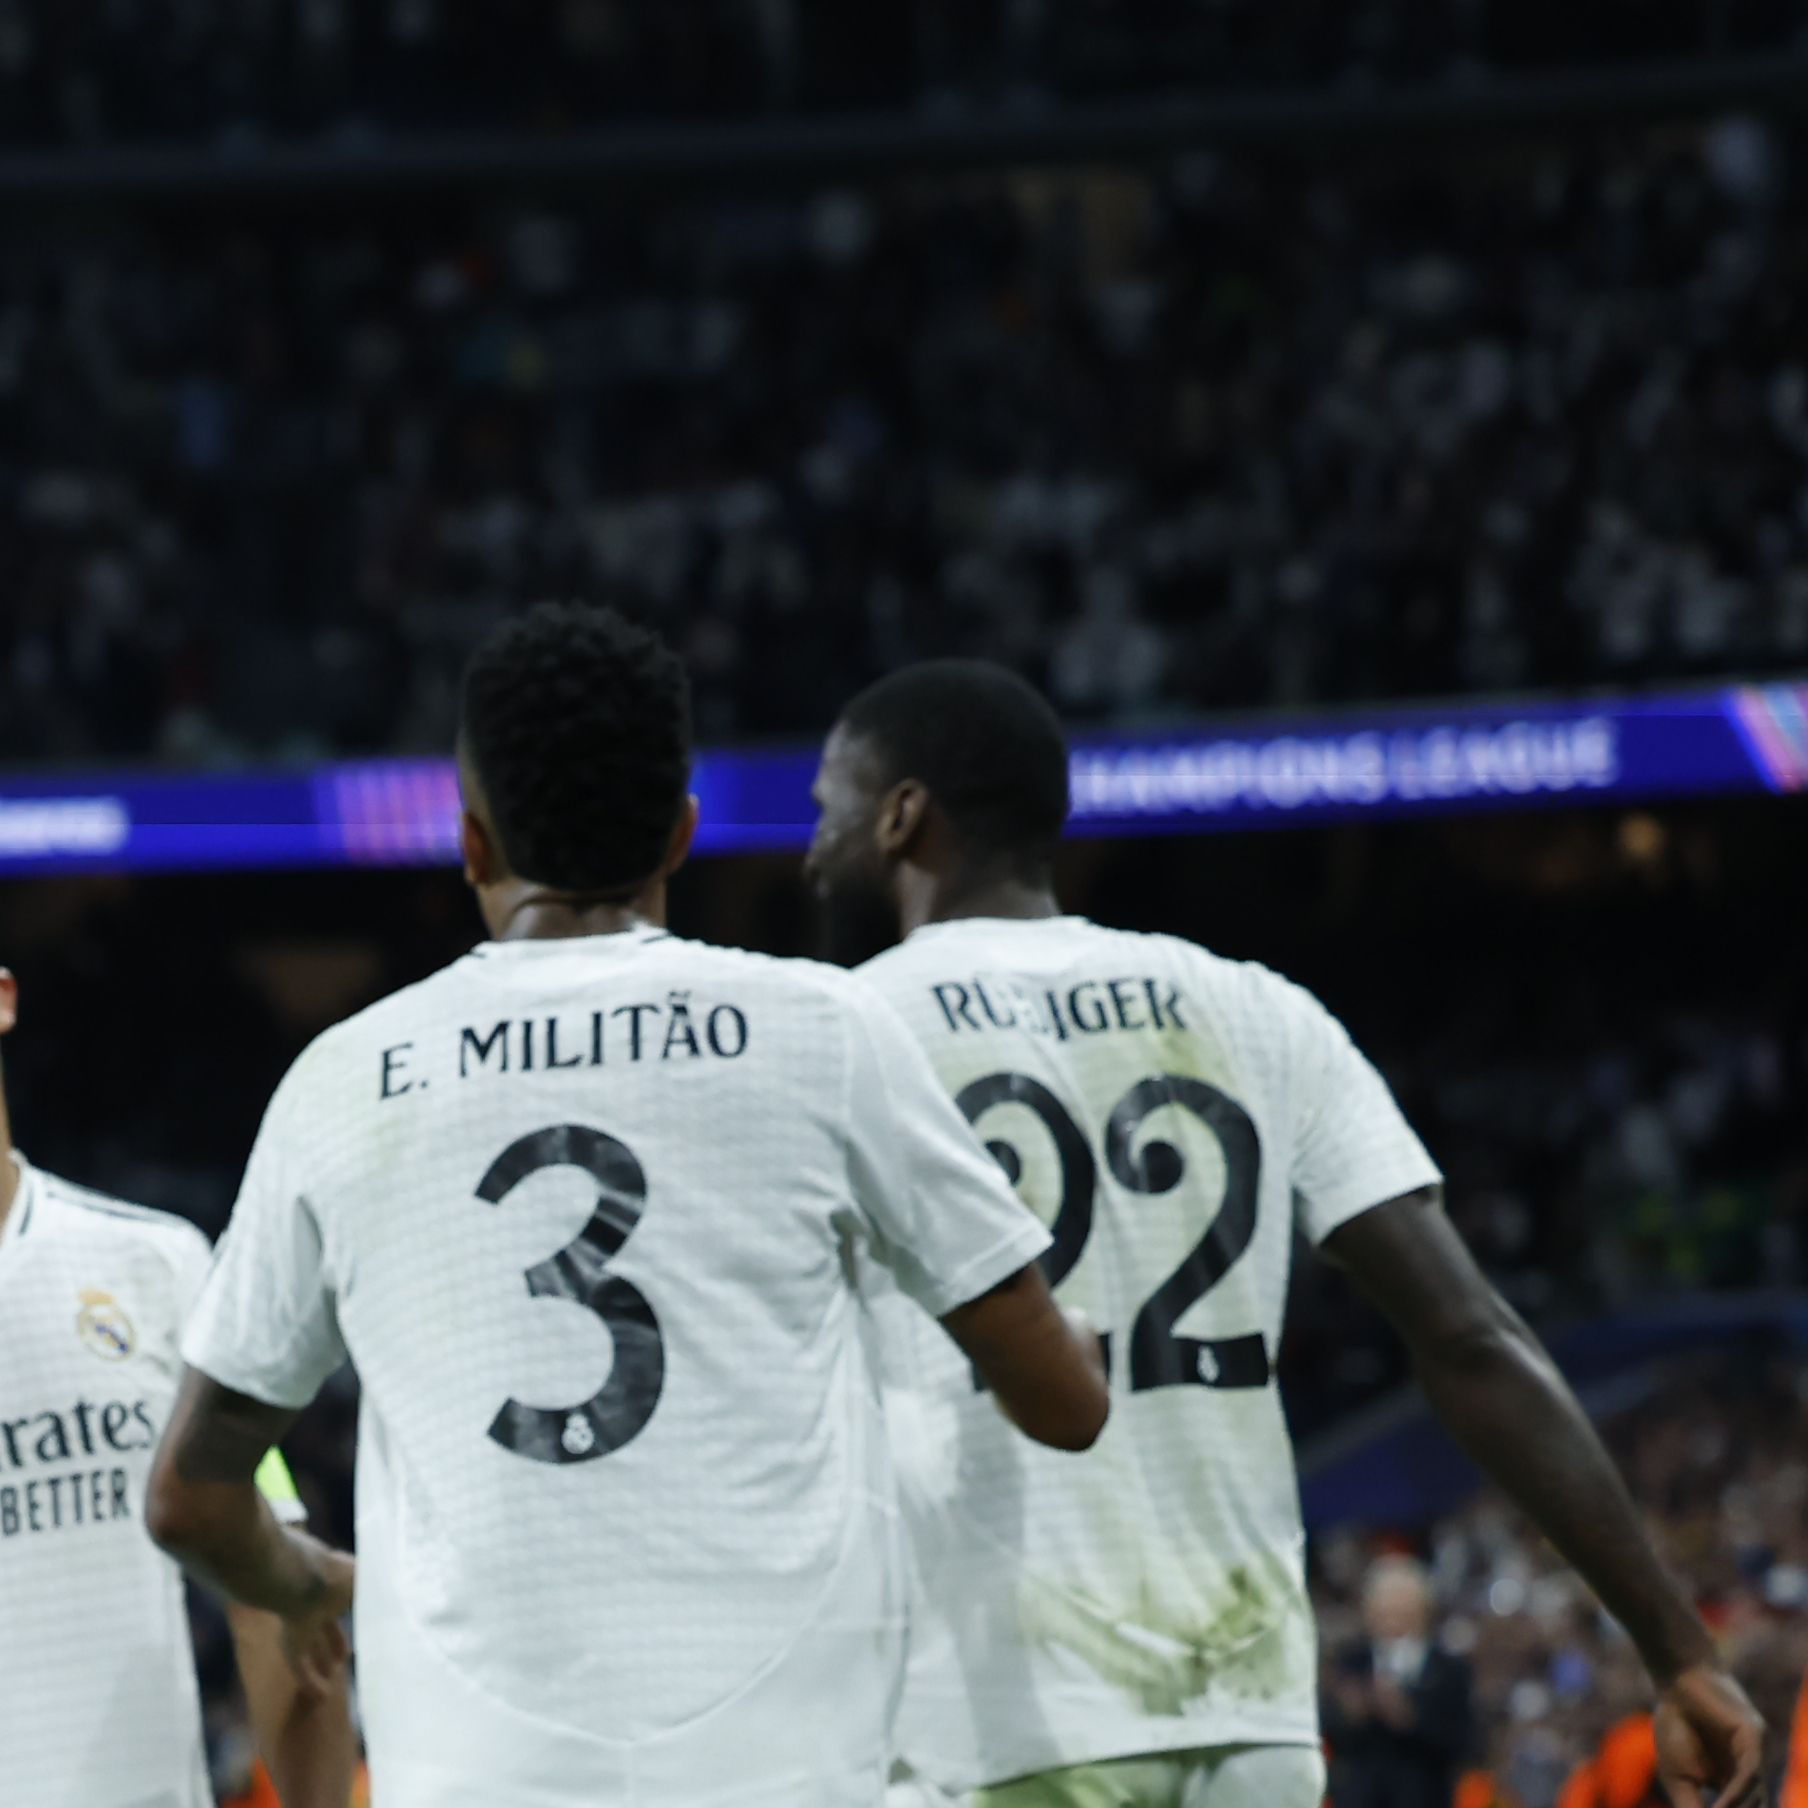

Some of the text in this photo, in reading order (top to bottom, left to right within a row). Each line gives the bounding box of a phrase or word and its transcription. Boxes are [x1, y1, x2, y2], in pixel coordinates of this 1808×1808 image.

[378, 990, 749, 1101] E. MILITÃO
[474, 1123, 666, 1467] 3
[0, 1467, 132, 1538] BETTER
